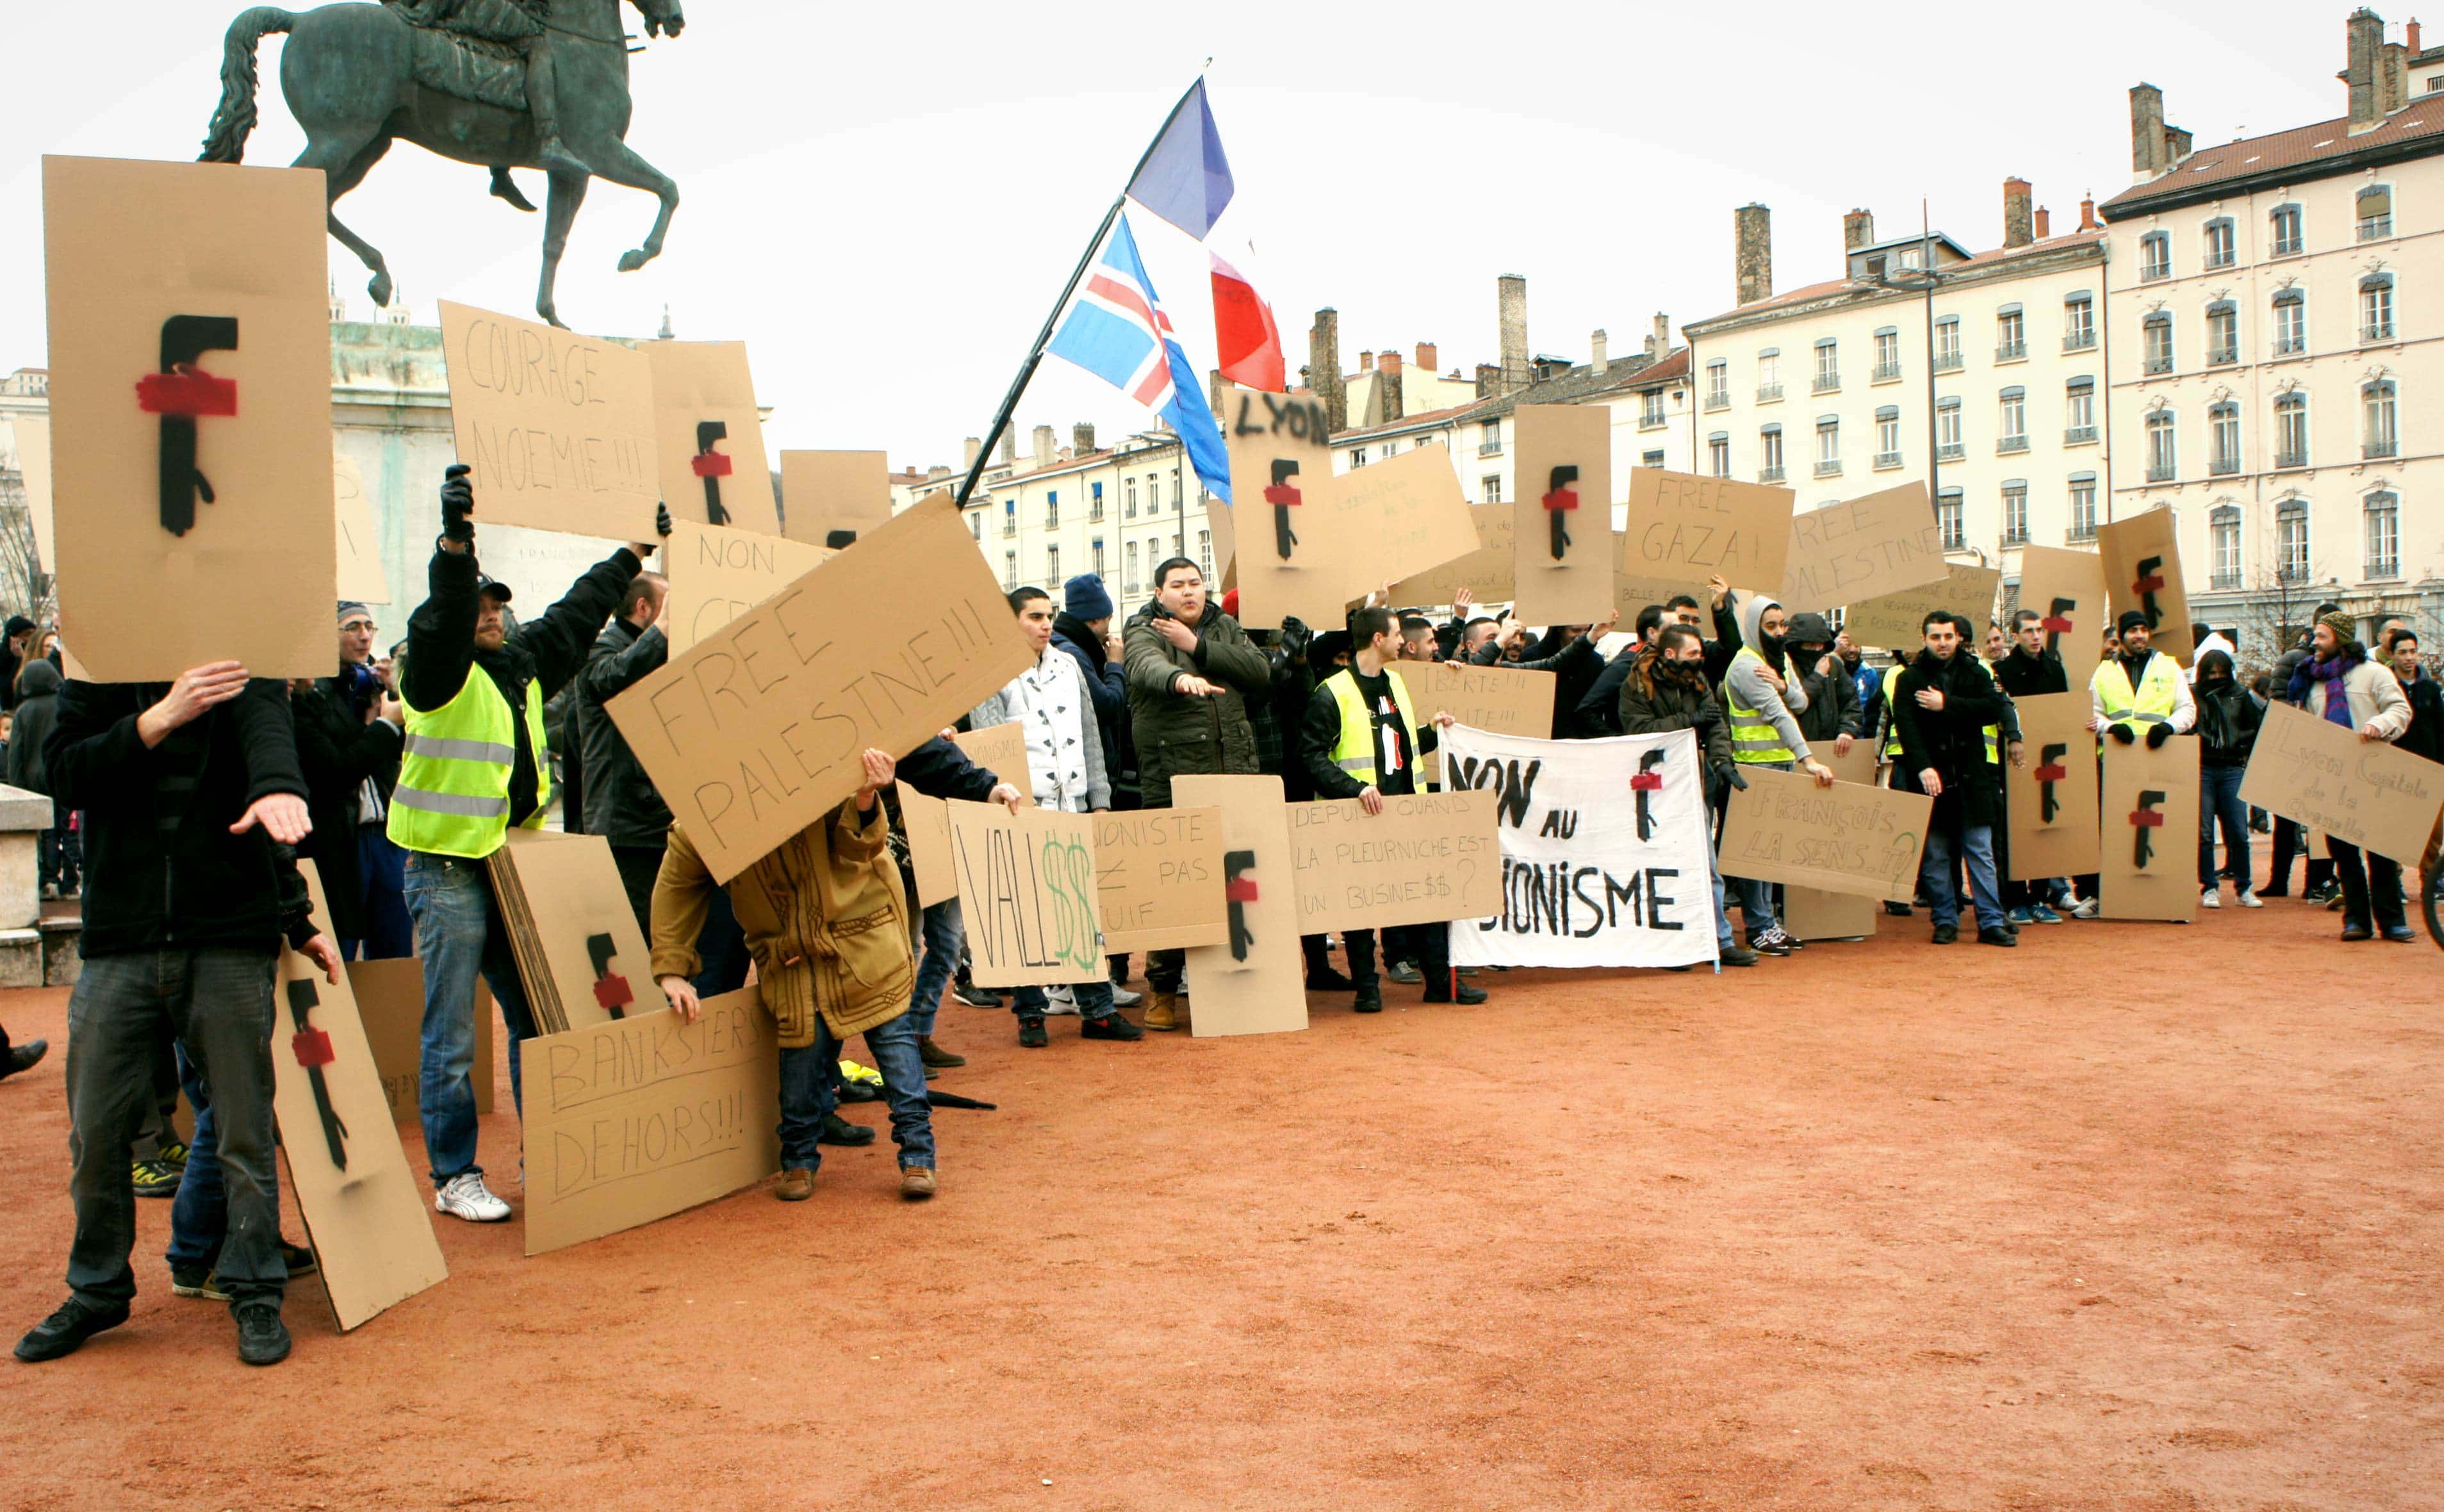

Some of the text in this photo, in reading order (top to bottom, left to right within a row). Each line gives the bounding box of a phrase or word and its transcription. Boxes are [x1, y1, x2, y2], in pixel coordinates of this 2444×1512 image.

[466, 319, 605, 406] COURAGE
[1234, 392, 1331, 447] LYON
[1656, 477, 1734, 514] FREE
[1794, 500, 1882, 549] REE
[700, 534, 774, 575] NON
[650, 589, 833, 757] FREE
[1448, 752, 1578, 839] NON AU
[1296, 835, 1489, 870] LA PLEURNICHE EST
[1742, 830, 1783, 862] LA
[1159, 857, 1208, 885] PAS
[1099, 901, 1154, 931] UIF
[1304, 894, 1327, 916] UN
[549, 1006, 760, 1113] BANKSTERS
